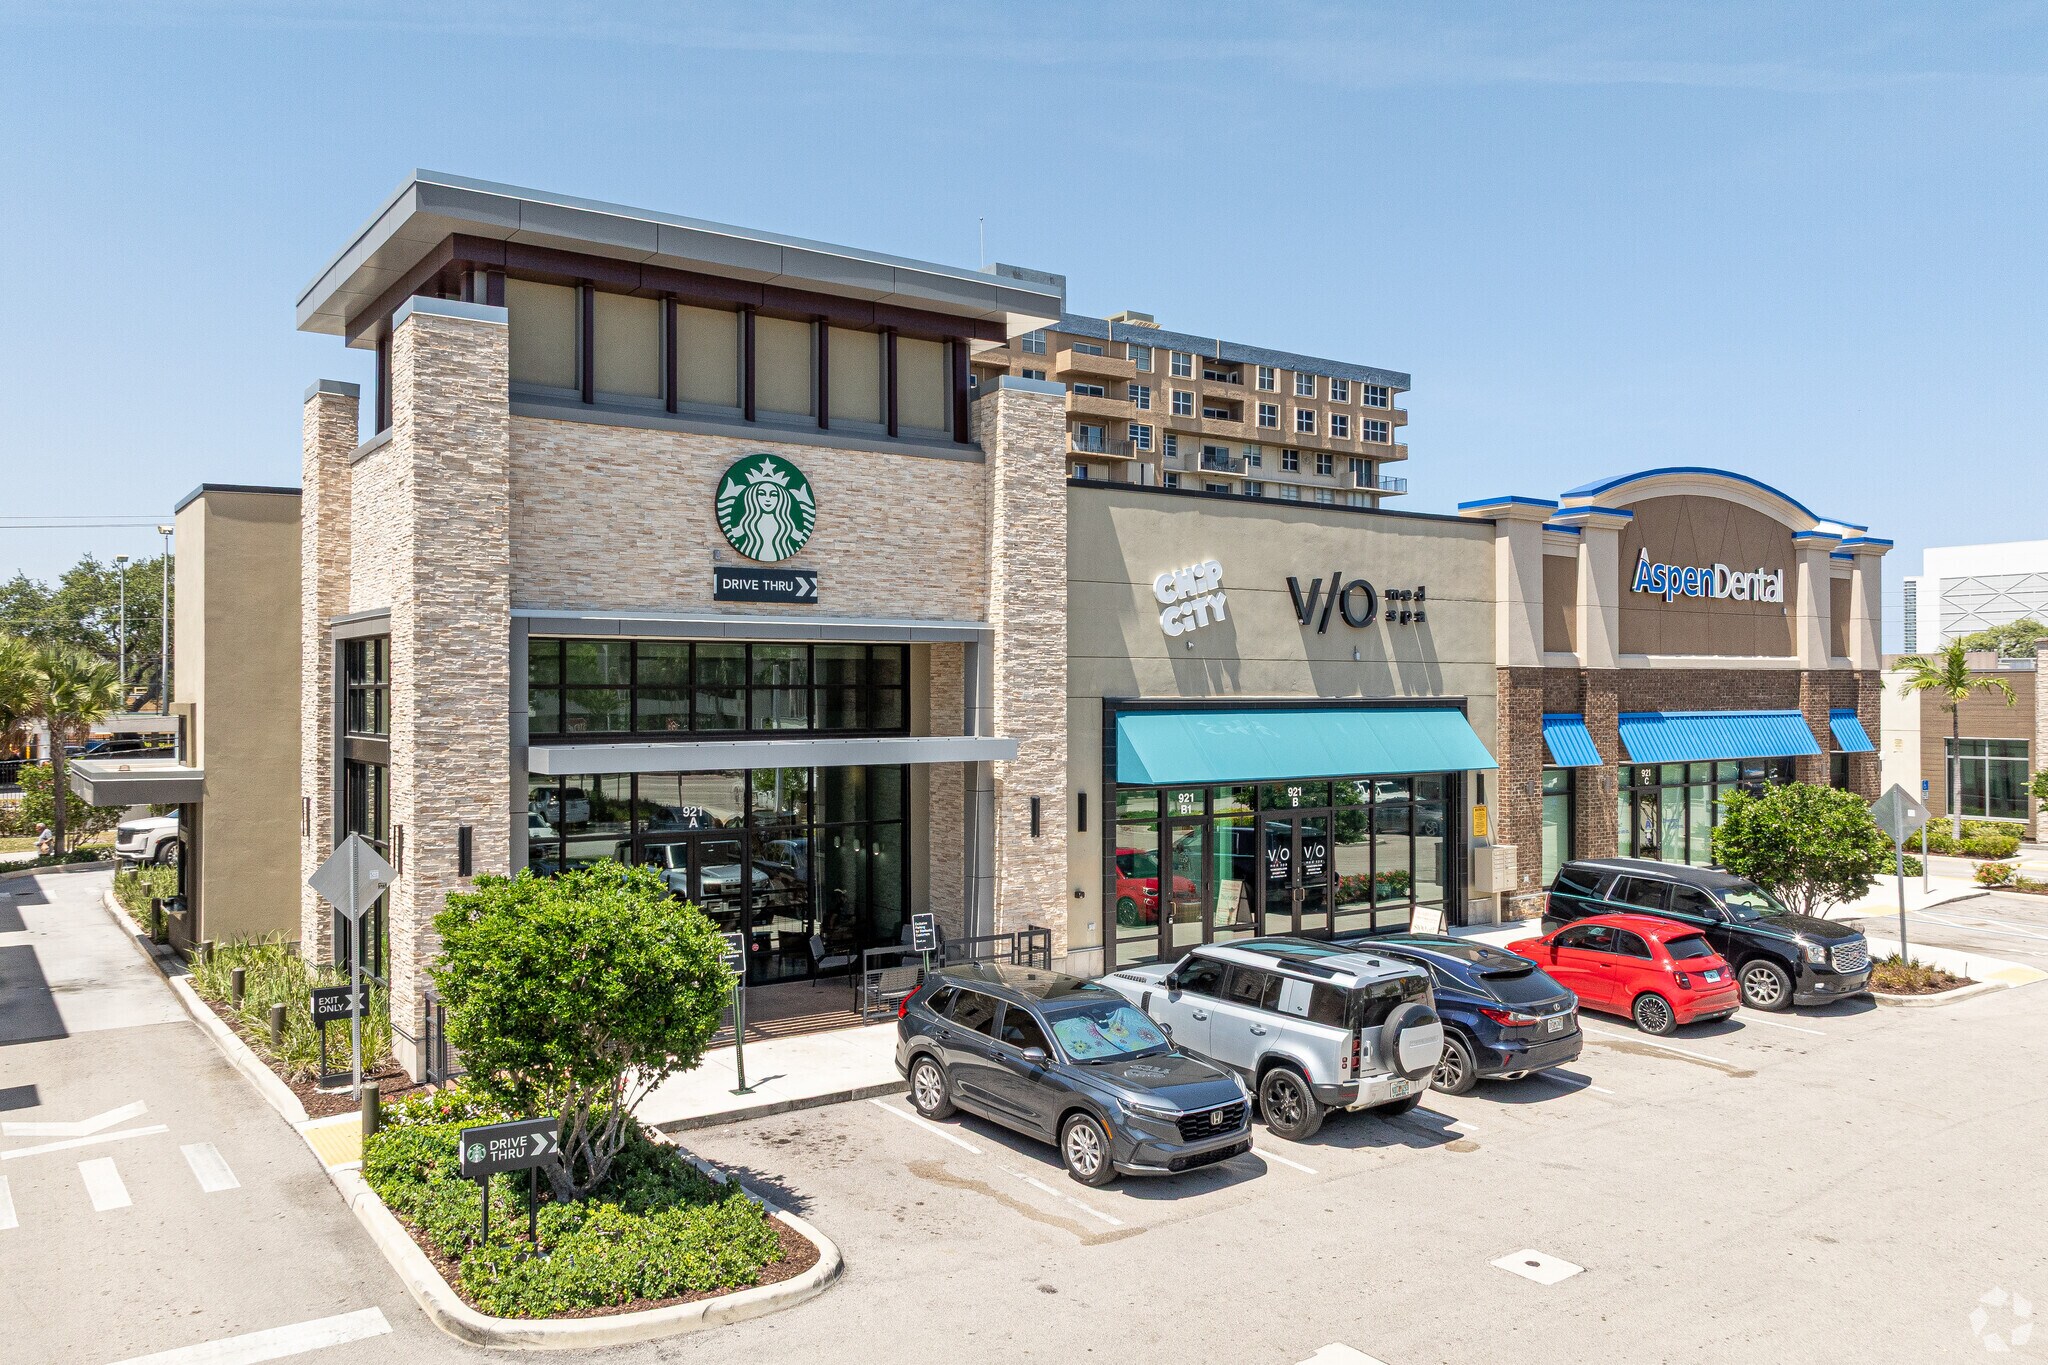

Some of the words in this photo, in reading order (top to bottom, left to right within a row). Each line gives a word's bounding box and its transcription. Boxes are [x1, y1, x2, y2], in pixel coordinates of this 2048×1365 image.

[722, 578, 759, 591] DRIVE
[763, 580, 794, 592] THRU
[1385, 586, 1425, 601] med
[1385, 610, 1425, 625] spa
[1641, 769, 1651, 777] 921
[1644, 777, 1650, 786] C
[1288, 787, 1302, 797] 921
[1178, 793, 1194, 803] 921
[1292, 797, 1299, 807] B
[682, 806, 703, 817] 921
[1180, 804, 1192, 815] B1
[688, 817, 699, 828] A
[1268, 845, 1290, 861] V/O
[1303, 842, 1325, 860] V/O
[318, 996, 339, 1006] EXIT
[318, 1003, 344, 1014] ONLY
[490, 1136, 528, 1151] DRIVE
[490, 1147, 525, 1162] THRU
